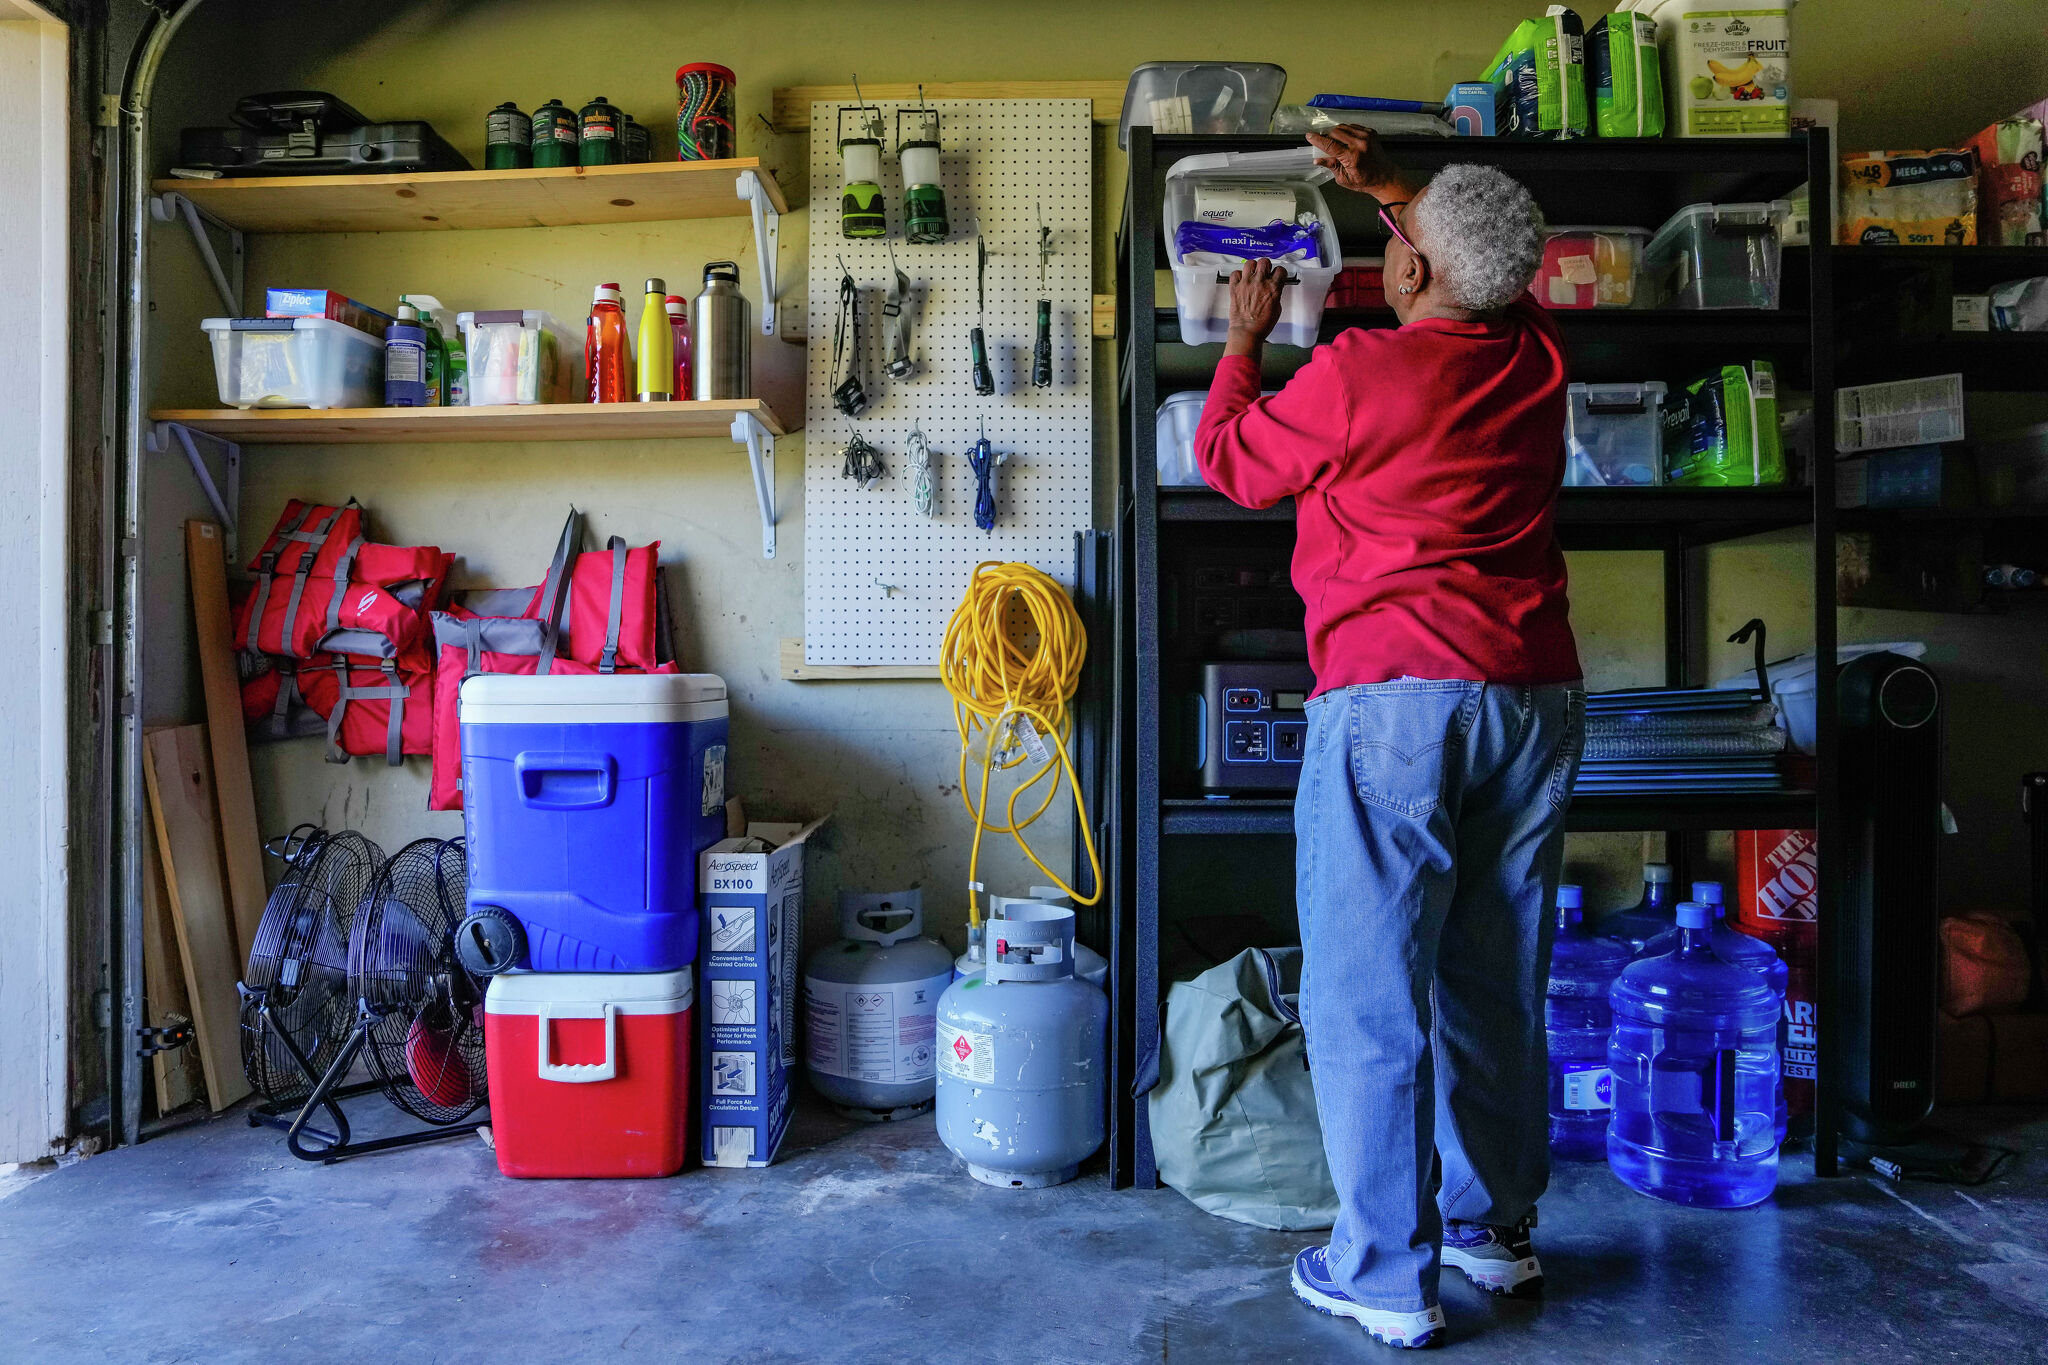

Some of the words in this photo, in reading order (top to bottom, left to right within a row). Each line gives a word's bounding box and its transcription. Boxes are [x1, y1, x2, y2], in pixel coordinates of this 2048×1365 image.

[1748, 40, 1786, 50] FRUIT
[1864, 165, 1882, 179] 48
[1896, 166, 1927, 177] MEGA
[1202, 209, 1234, 219] equate
[1222, 237, 1247, 245] maxi
[282, 291, 312, 307] Ziploc
[1764, 830, 1810, 870] THE
[708, 859, 758, 872] Aerospeed
[714, 879, 753, 889] BX100
